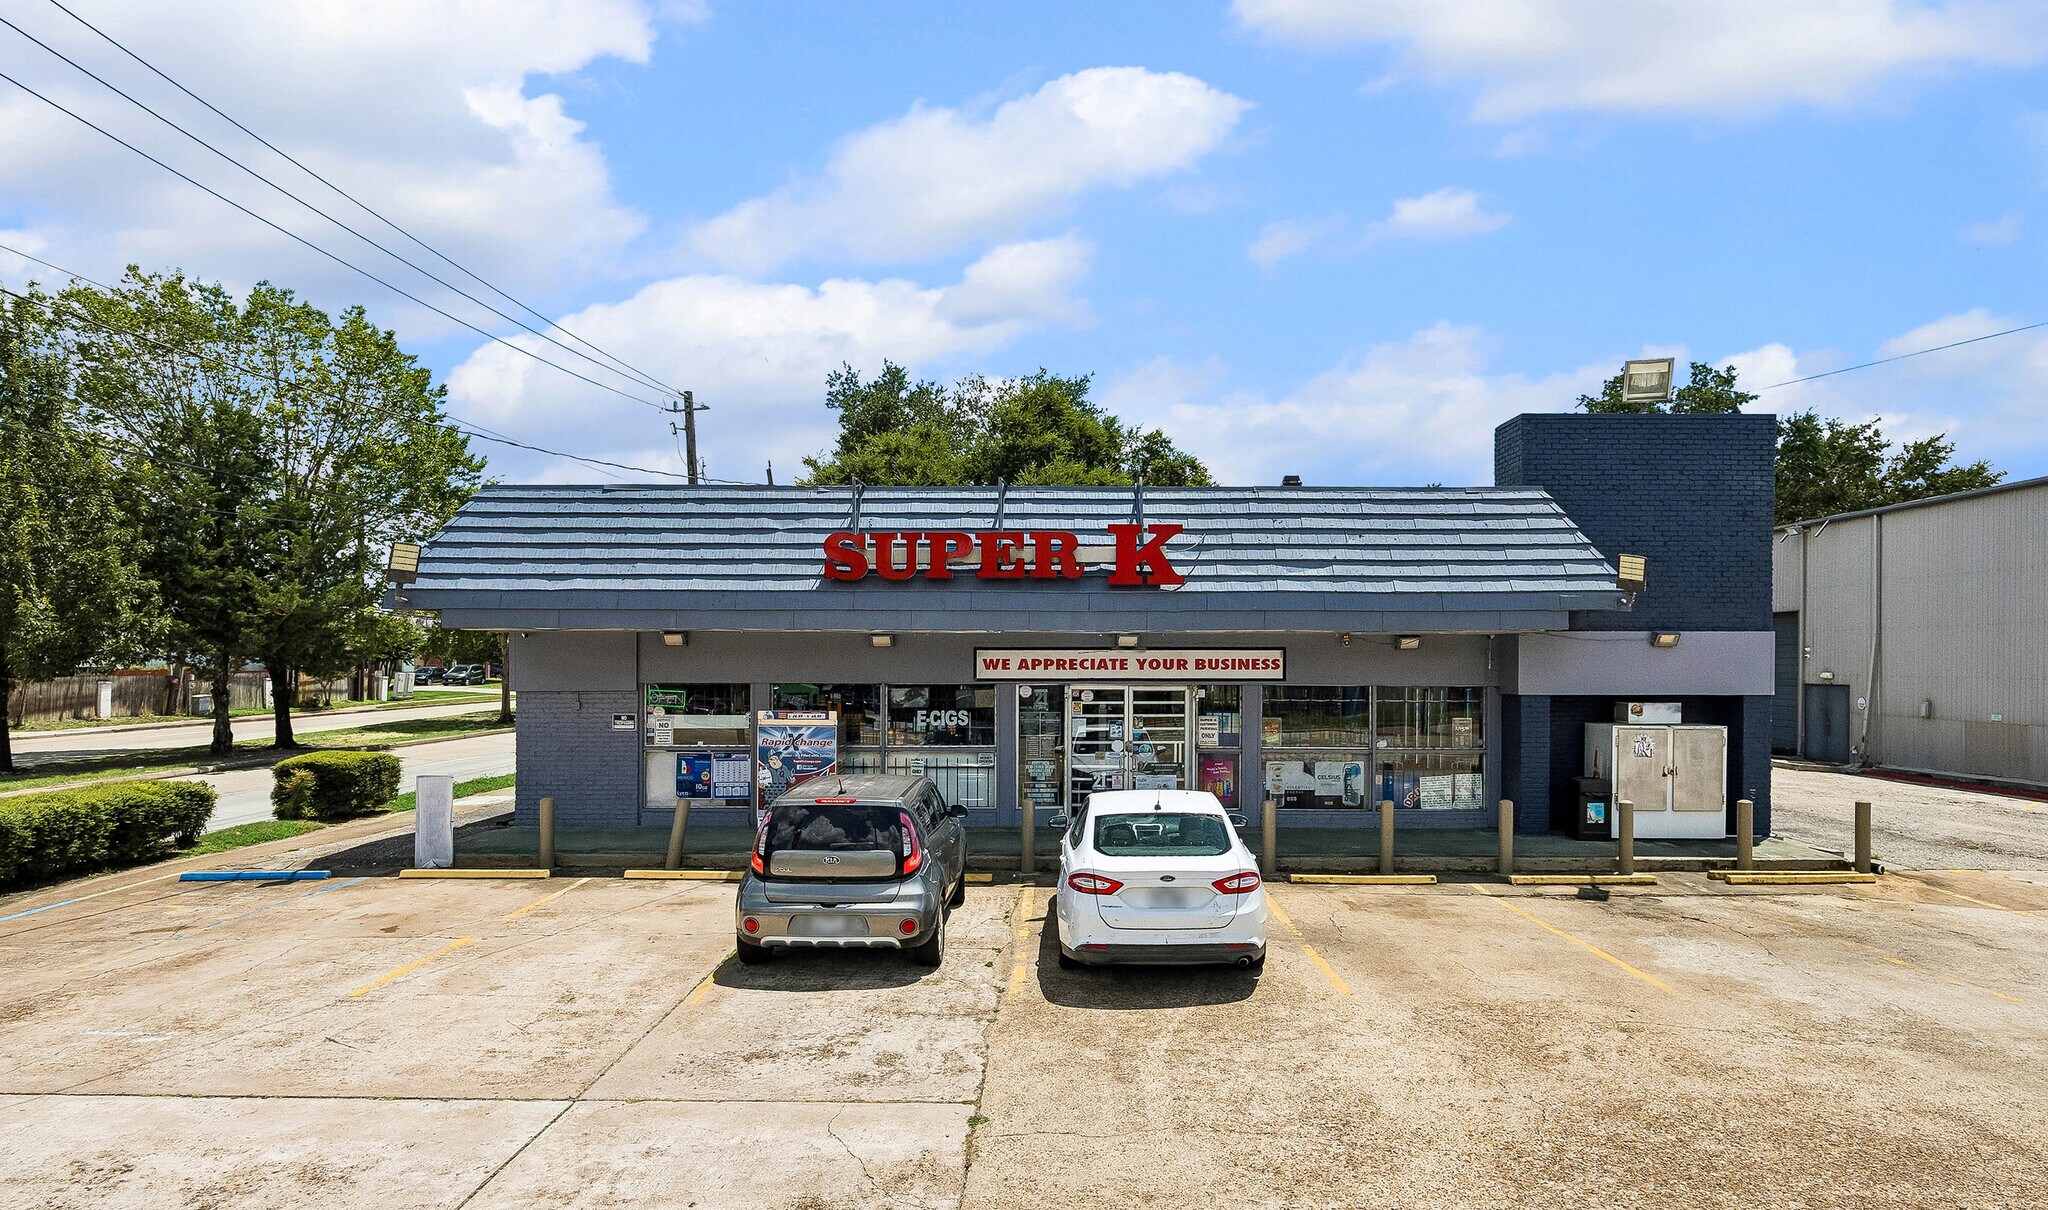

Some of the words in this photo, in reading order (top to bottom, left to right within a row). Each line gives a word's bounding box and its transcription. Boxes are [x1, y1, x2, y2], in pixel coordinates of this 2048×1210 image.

[823, 532, 1085, 581] SUPER
[1107, 523, 1185, 586] K
[982, 658, 1011, 671] WE
[1017, 658, 1129, 671] APPRECIATE
[1136, 658, 1189, 671] YOUR
[1194, 658, 1281, 671] BUSINESS
[916, 709, 969, 727] E-CIGS
[1092, 773, 1106, 787] 21
